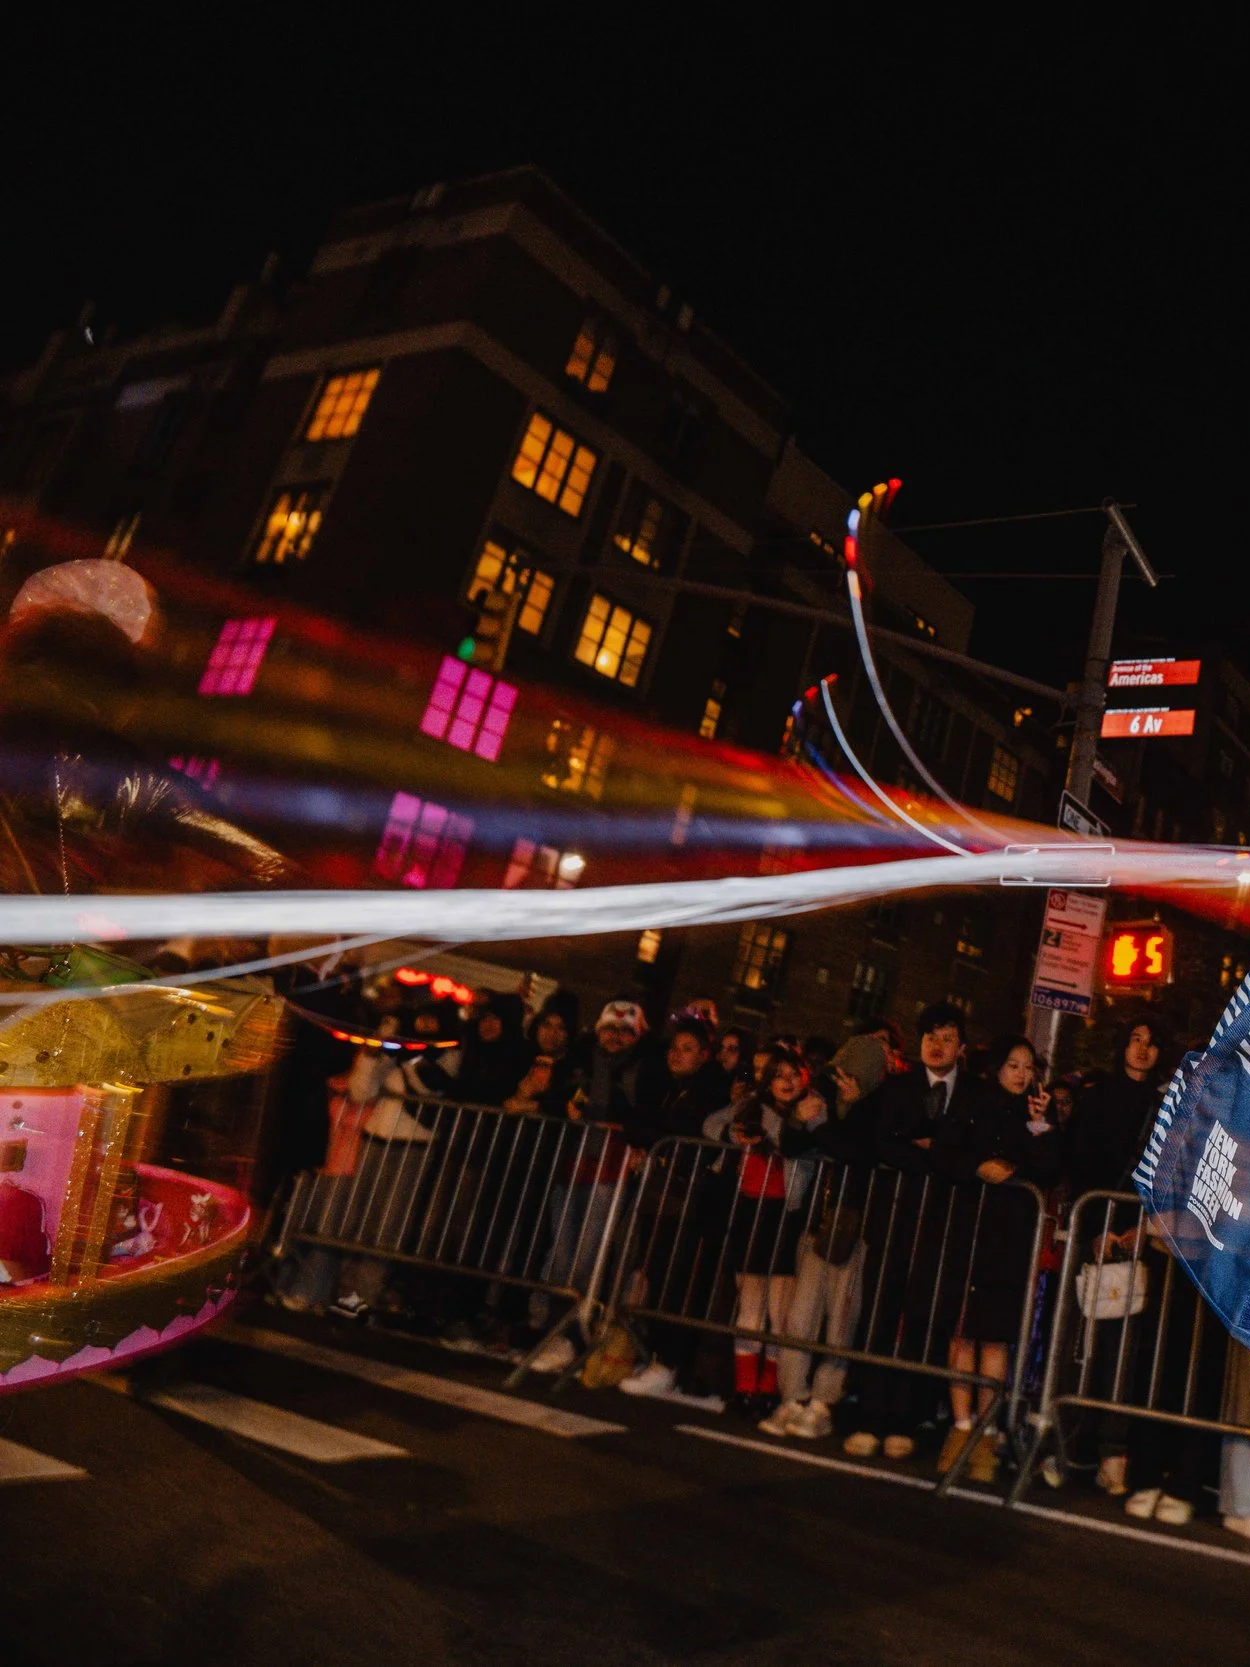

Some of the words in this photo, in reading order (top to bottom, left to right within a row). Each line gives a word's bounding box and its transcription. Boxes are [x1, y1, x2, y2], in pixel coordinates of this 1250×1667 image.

[1108, 671, 1164, 687] Americas
[1112, 665, 1134, 673] Avenue
[1142, 664, 1153, 672] the
[1129, 715, 1141, 735] 6
[1142, 714, 1163, 734] Av
[1146, 936, 1163, 974] 5
[1208, 1119, 1239, 1162] NEW
[1202, 1137, 1238, 1188] YORK
[1191, 1175, 1223, 1223] WEEK
[1195, 1157, 1244, 1221] FASHION
